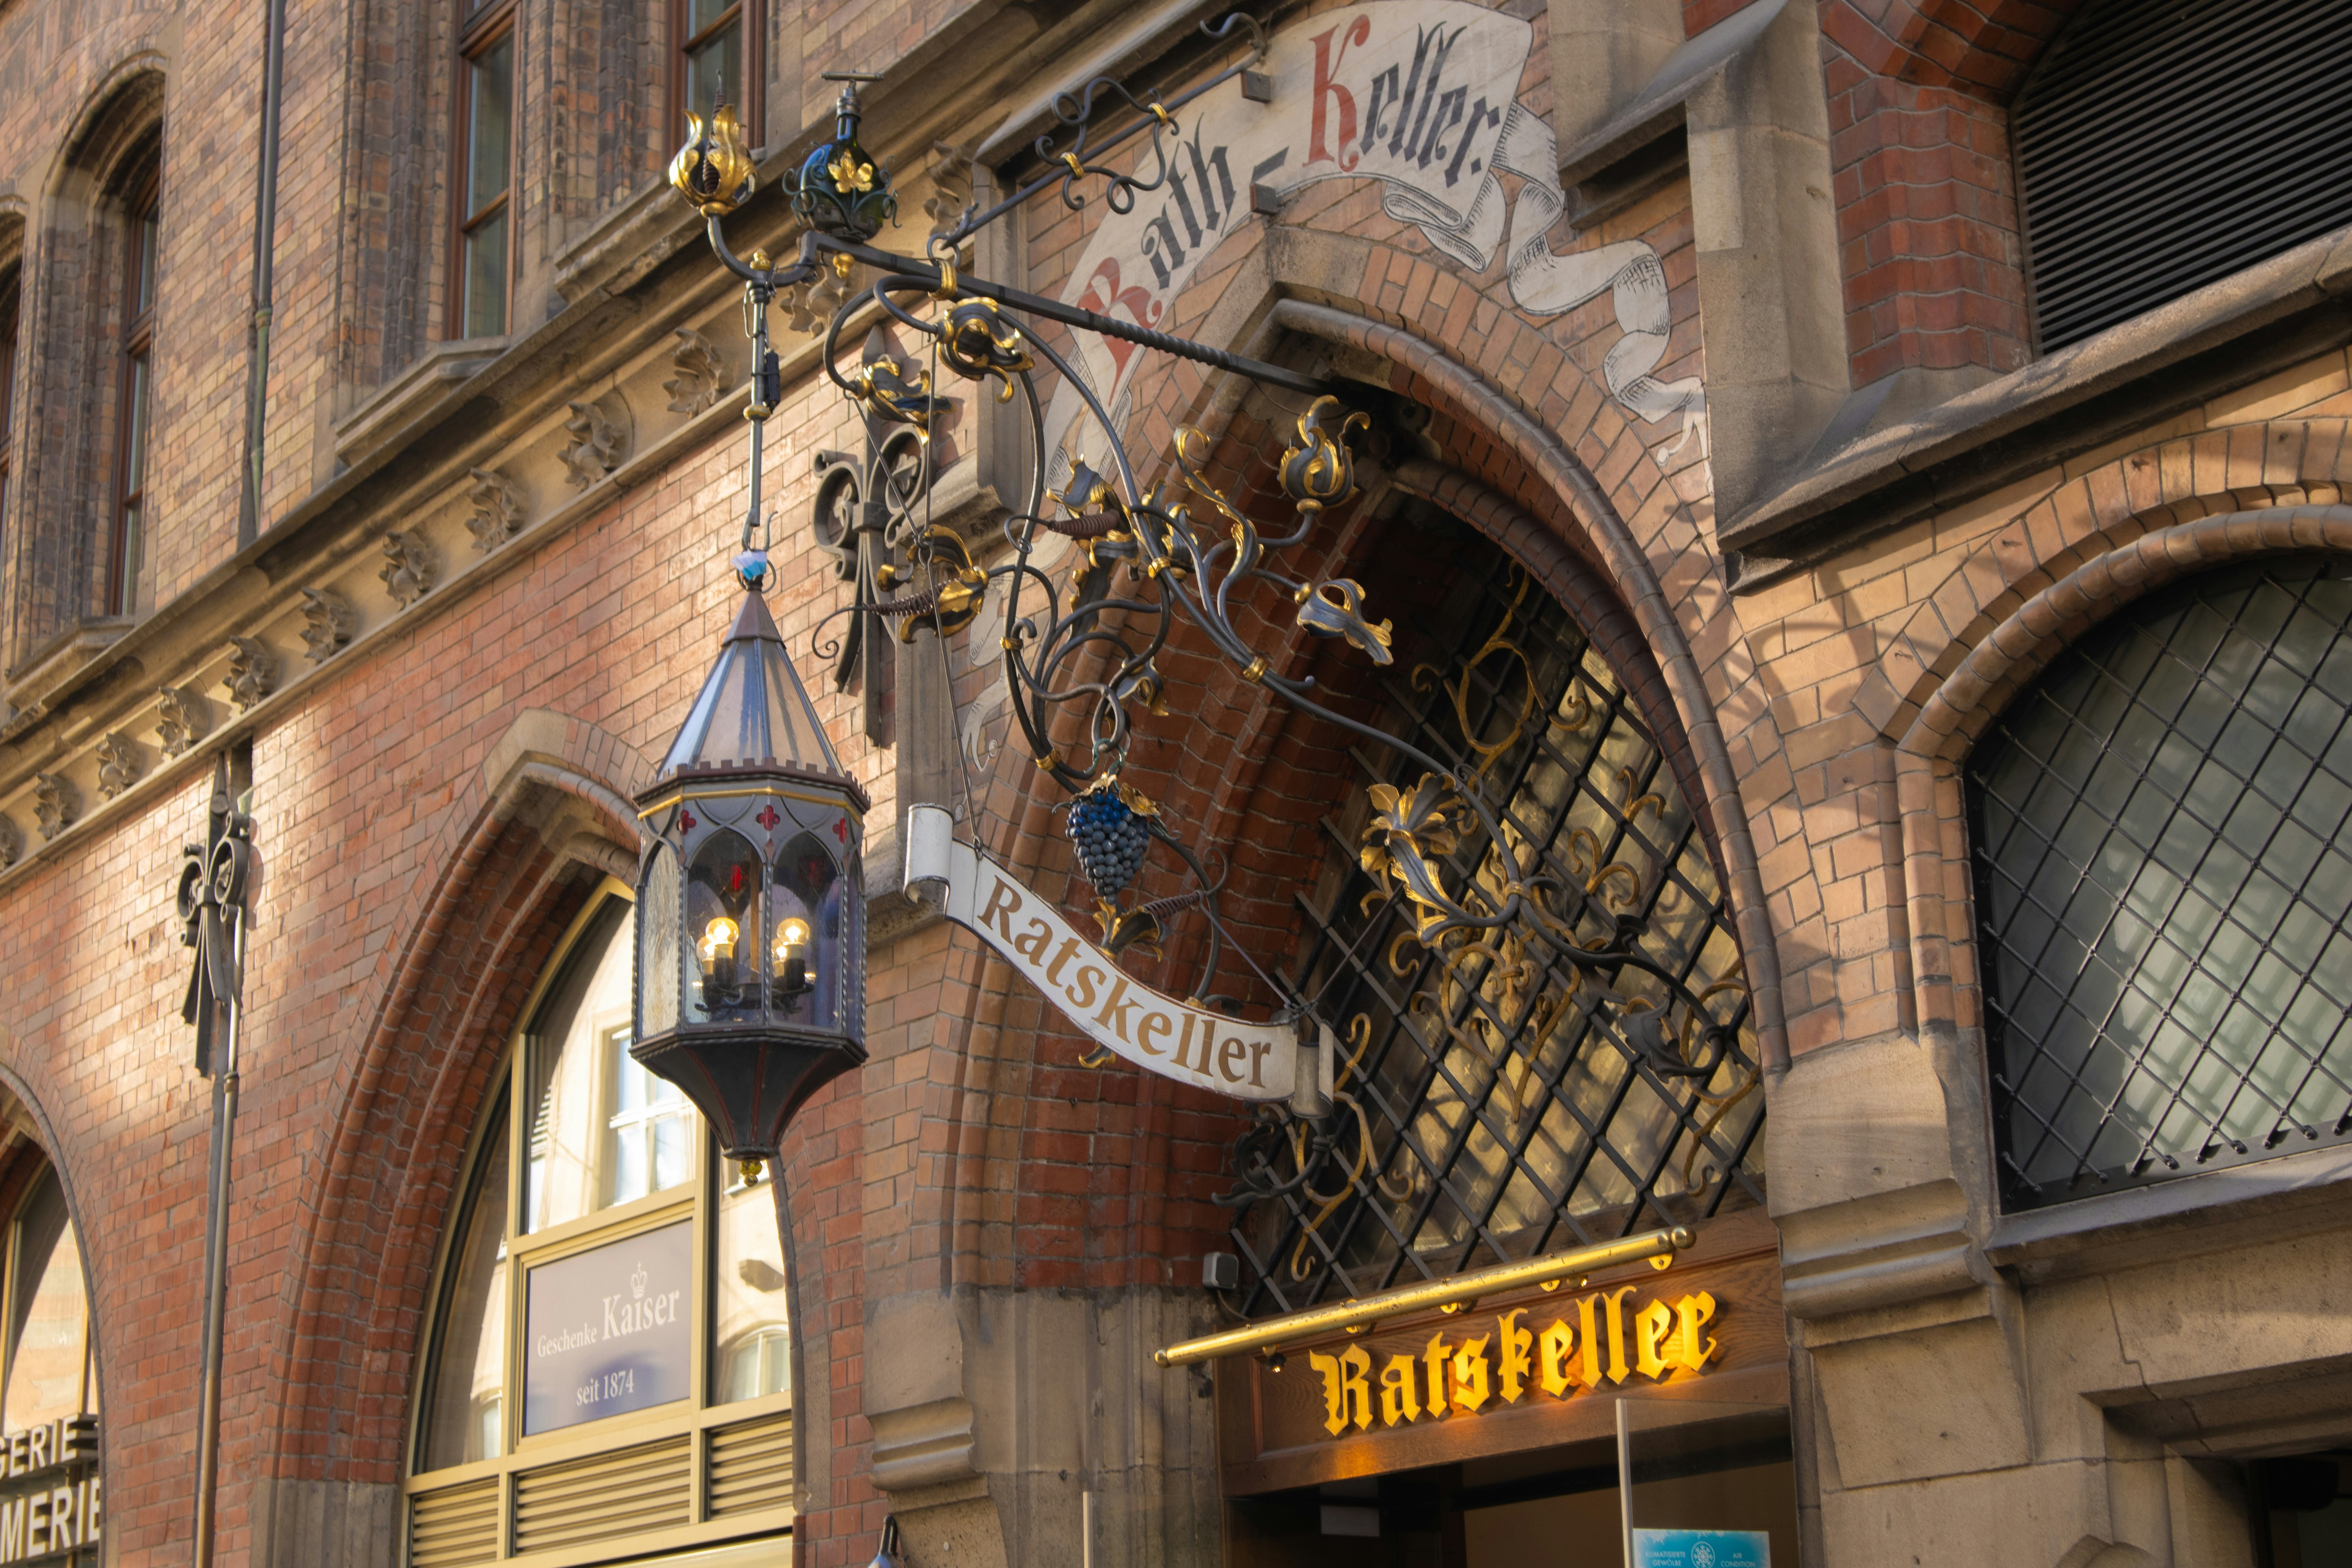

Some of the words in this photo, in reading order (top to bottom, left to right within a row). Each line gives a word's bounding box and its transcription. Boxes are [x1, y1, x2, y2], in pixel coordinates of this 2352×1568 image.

[977, 874, 1271, 1088] Ratskeller
[537, 1322, 597, 1357] Geschenke
[602, 1290, 679, 1341] Kaiser
[576, 1377, 599, 1406] seit
[603, 1368, 634, 1399] 1874
[1309, 1285, 1717, 1437] Ratskeller
[1653, 1558, 1681, 1566] GEWÖLBE
